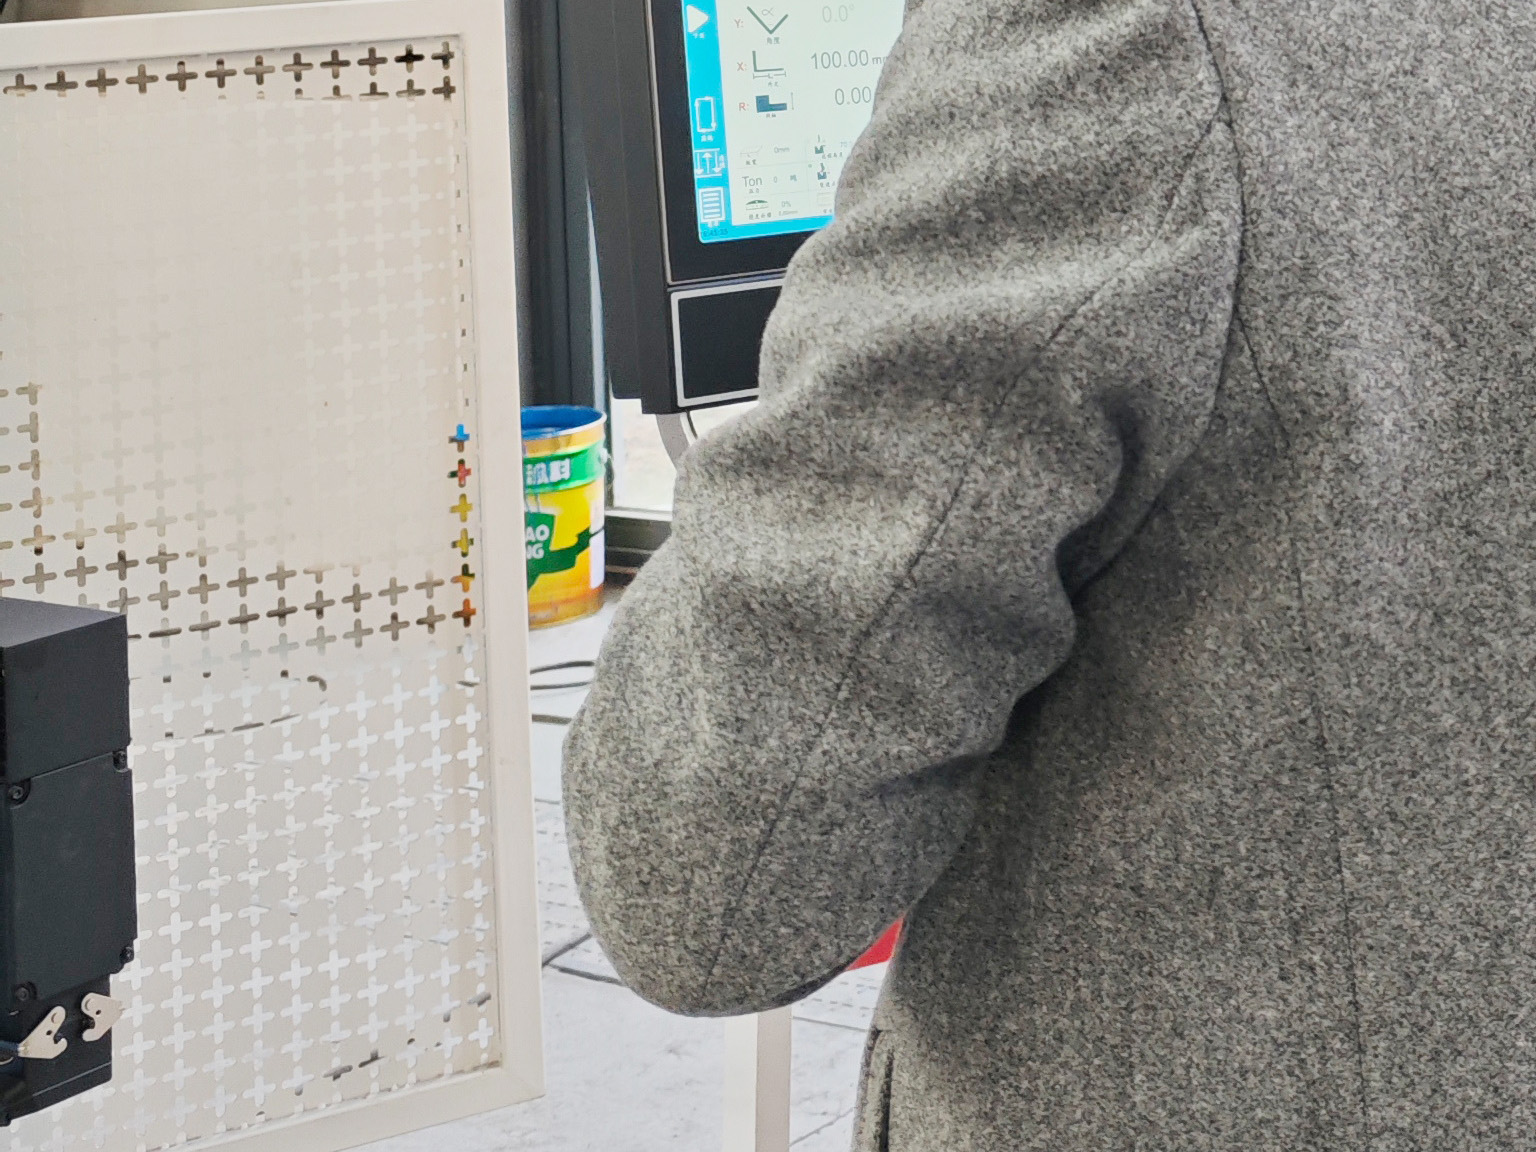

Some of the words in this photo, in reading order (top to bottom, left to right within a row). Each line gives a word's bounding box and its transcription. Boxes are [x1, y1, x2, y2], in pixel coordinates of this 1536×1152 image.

[734, 19, 744, 29] Y:
[737, 62, 747, 72] X:
[810, 49, 869, 70] 100.00
[738, 101, 748, 112] R:
[834, 86, 872, 106] 0.00
[742, 175, 763, 188] Ton
